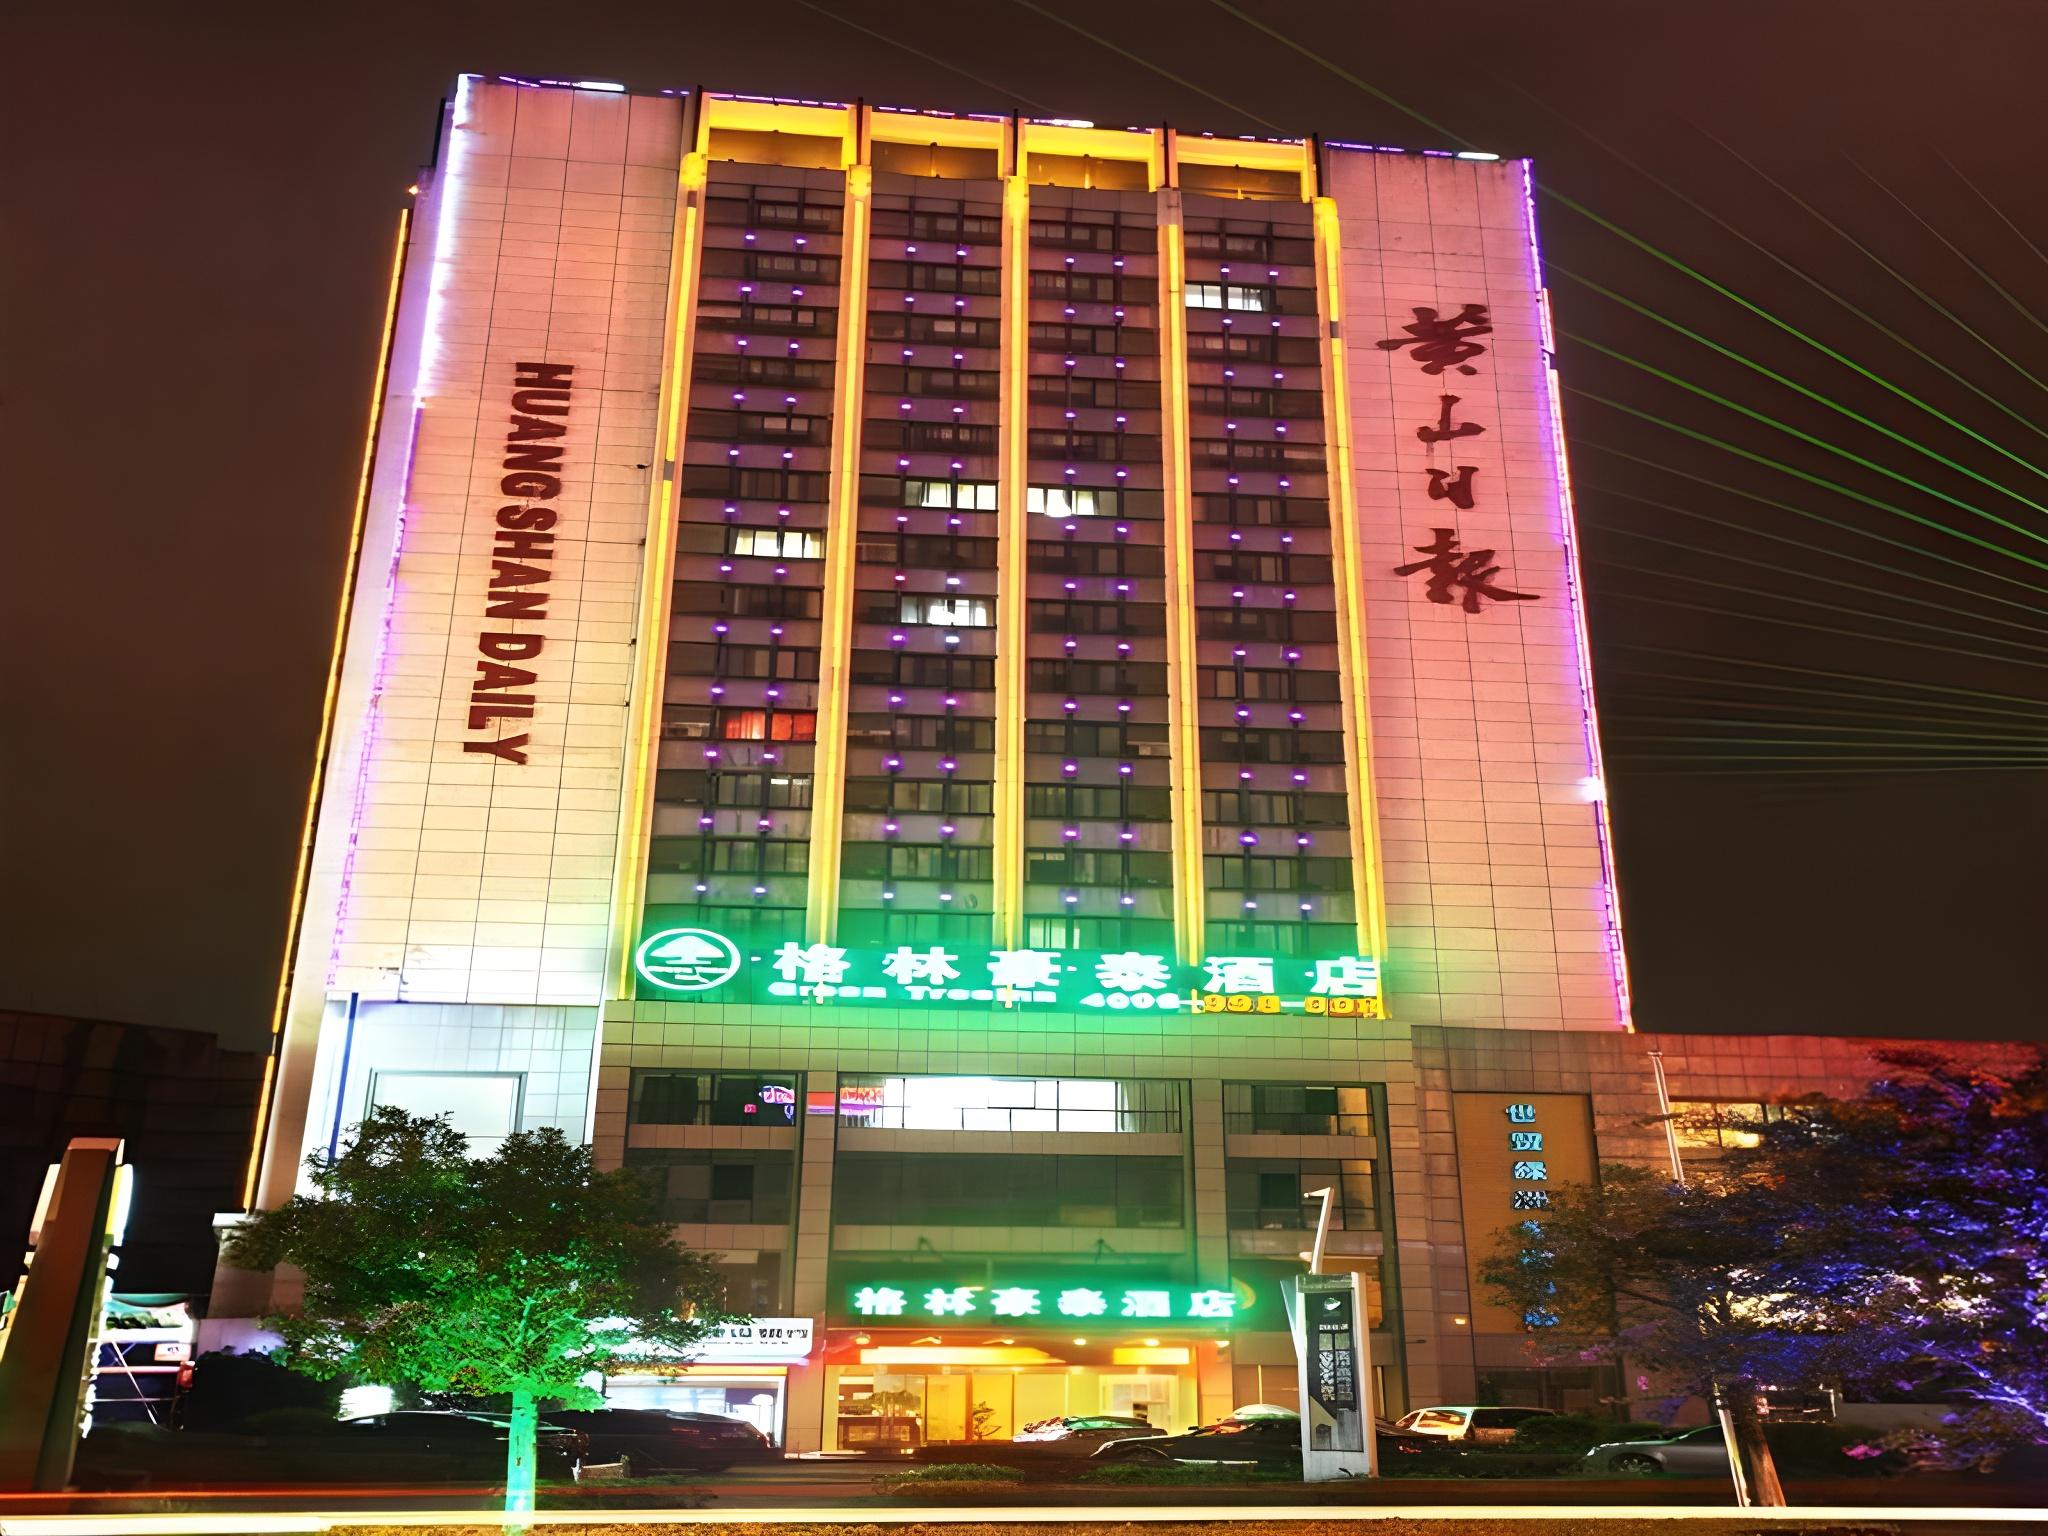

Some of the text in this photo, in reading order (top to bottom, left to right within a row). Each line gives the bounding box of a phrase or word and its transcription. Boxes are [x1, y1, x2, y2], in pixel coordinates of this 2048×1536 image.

[463, 362, 574, 765] HUANGSHAN DAILY
[772, 941, 1378, 996] 格林豪泰酒店
[854, 1286, 1236, 1317] 格林豪泰酒店
